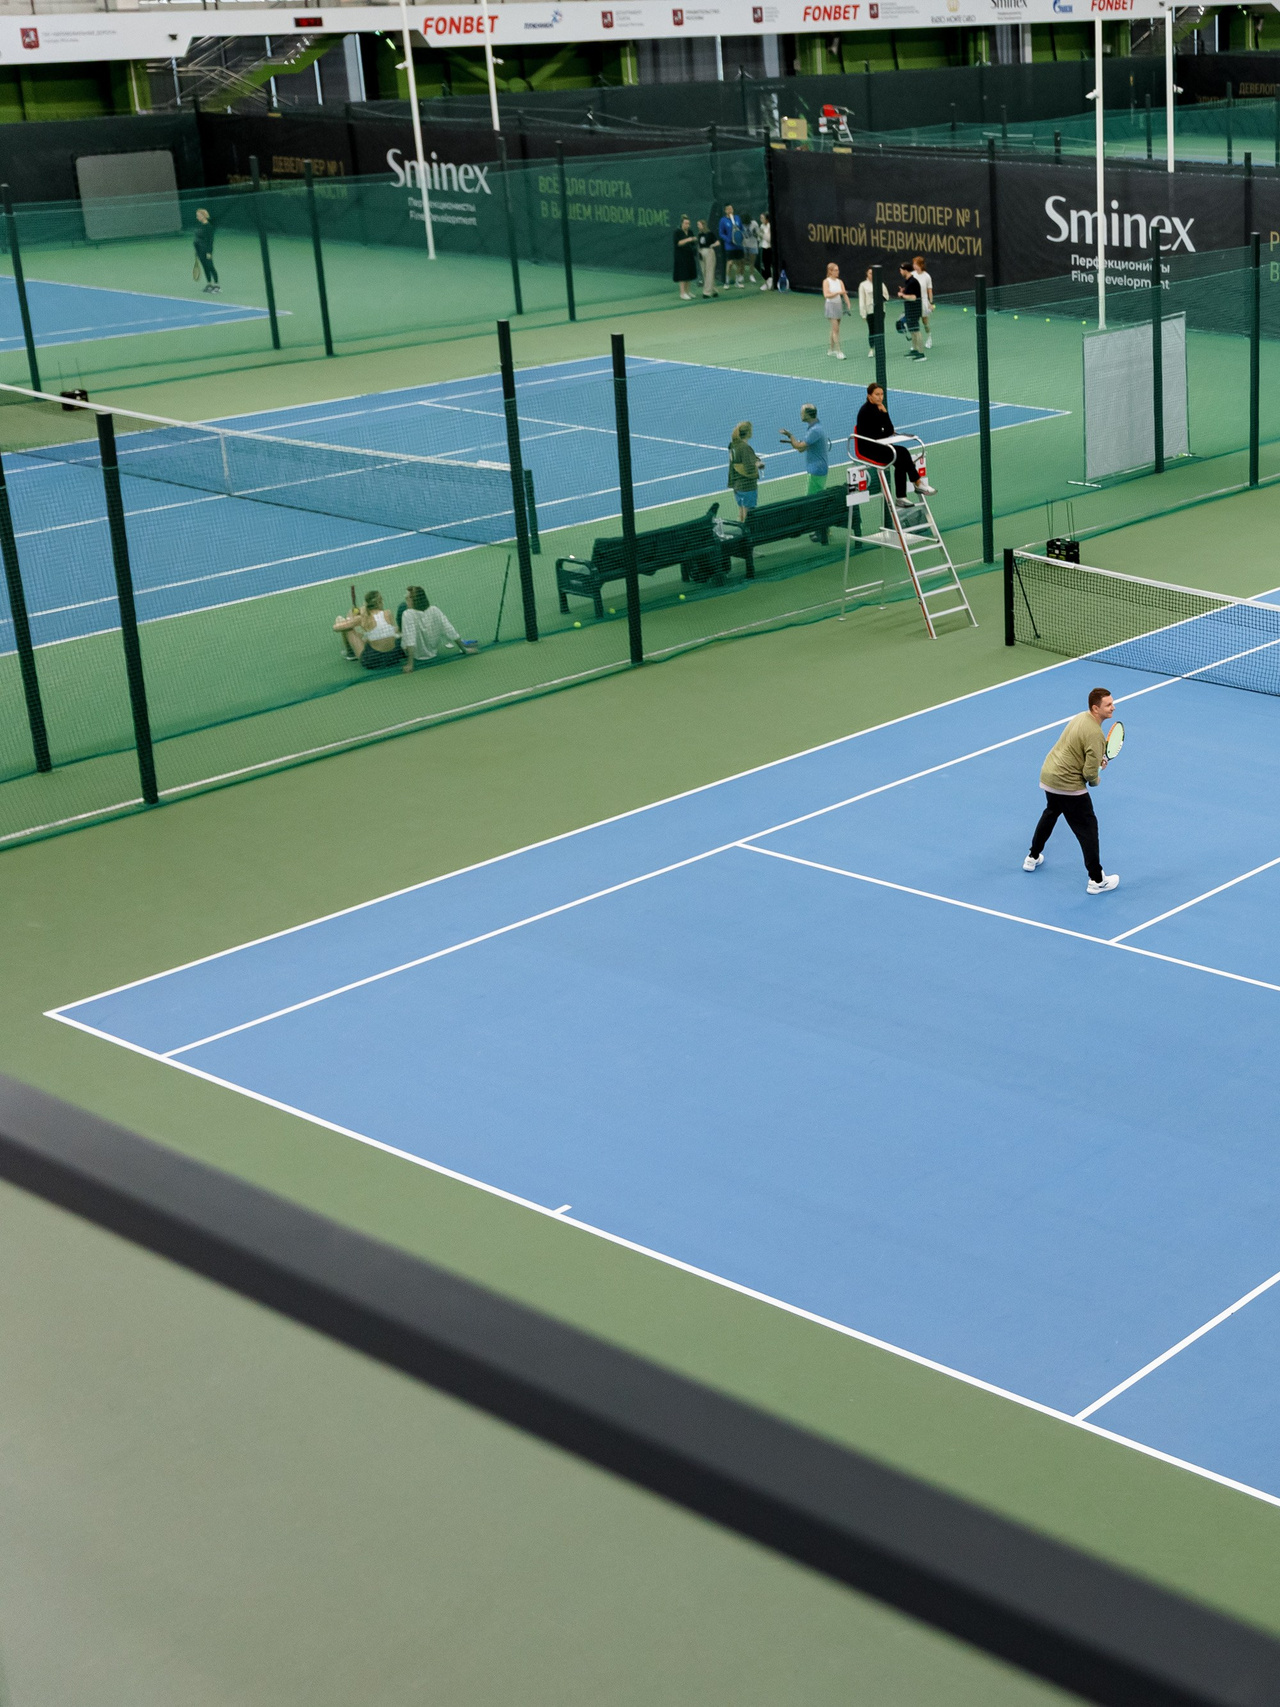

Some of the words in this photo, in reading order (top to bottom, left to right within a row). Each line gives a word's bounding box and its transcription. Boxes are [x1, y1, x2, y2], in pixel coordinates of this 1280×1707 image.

[803, 4, 860, 22] FONBET
[423, 15, 498, 35] FONBET
[386, 148, 492, 195] Sminex
[638, 207, 671, 228] ДОМЕ
[875, 202, 953, 227] ДЕВЕЛОПЕР
[956, 208, 971, 229] №
[974, 209, 980, 228] 1
[1044, 195, 1196, 253] Sminex
[807, 223, 867, 247] ЭЛИТНОЙ
[870, 229, 982, 257] НЕДВИЖИМОСТИ
[1071, 270, 1095, 283] Fine
[1269, 261, 1280, 282] В
